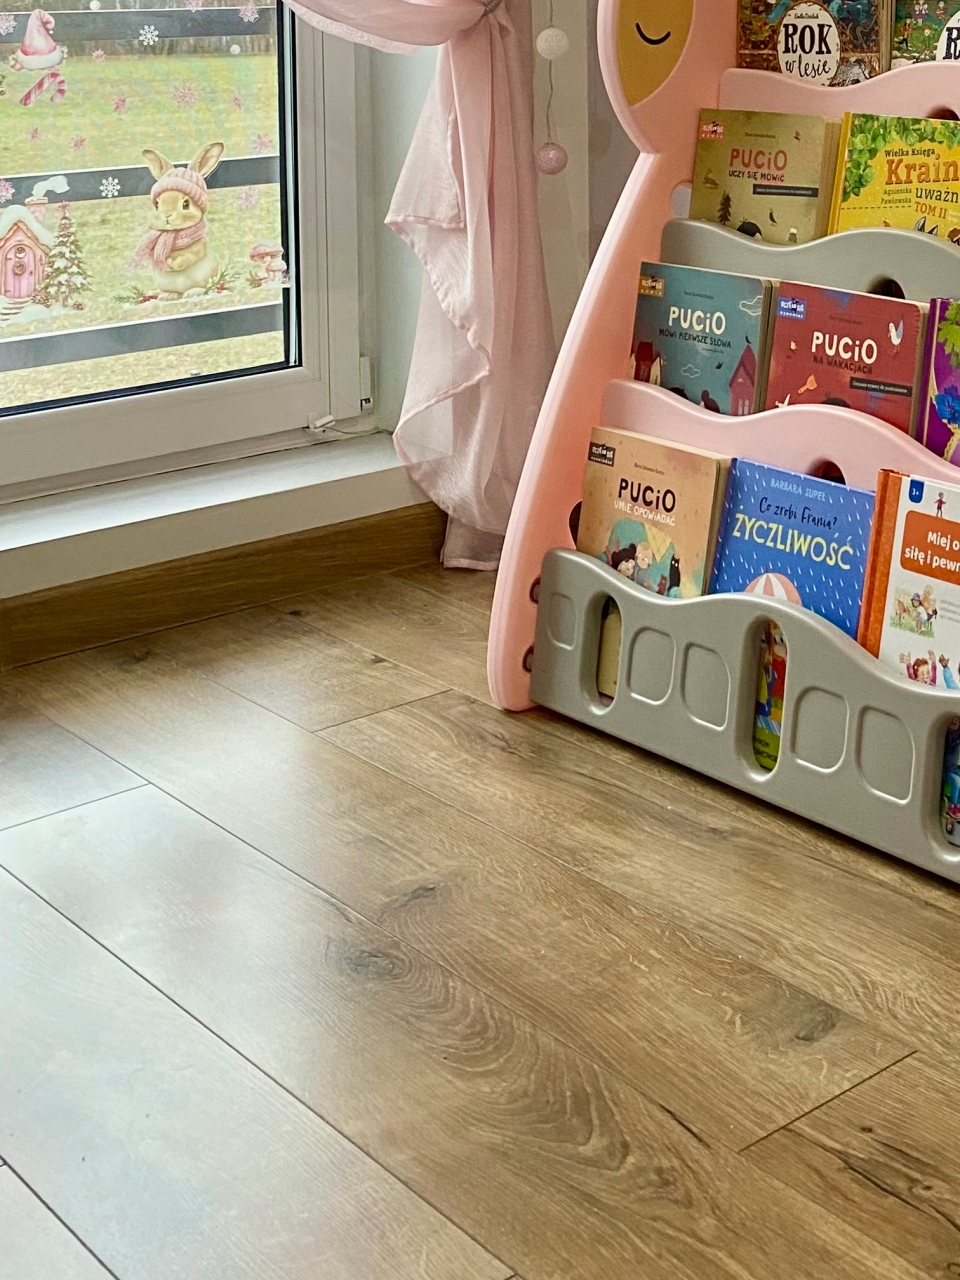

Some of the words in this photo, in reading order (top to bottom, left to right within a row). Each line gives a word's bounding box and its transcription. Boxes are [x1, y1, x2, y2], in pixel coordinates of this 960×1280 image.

[782, 23, 832, 55] ROK
[785, 60, 797, 73] w
[798, 53, 832, 79] lesie
[884, 149, 909, 158] Wielka
[911, 147, 936, 158] Księga
[883, 186, 912, 195] Agnieszka
[914, 201, 936, 217] TOM
[938, 208, 948, 220] II
[770, 478, 802, 496] BARBARA
[805, 487, 827, 502] SUPEŁ
[759, 496, 773, 514] Co
[773, 504, 797, 520] zrobi
[801, 506, 838, 531] Frania?
[732, 504, 854, 570] ŻYCZLIWOŚĆ
[927, 531, 952, 550] Miej
[904, 546, 925, 567] siłę
[926, 550, 932, 565] i
